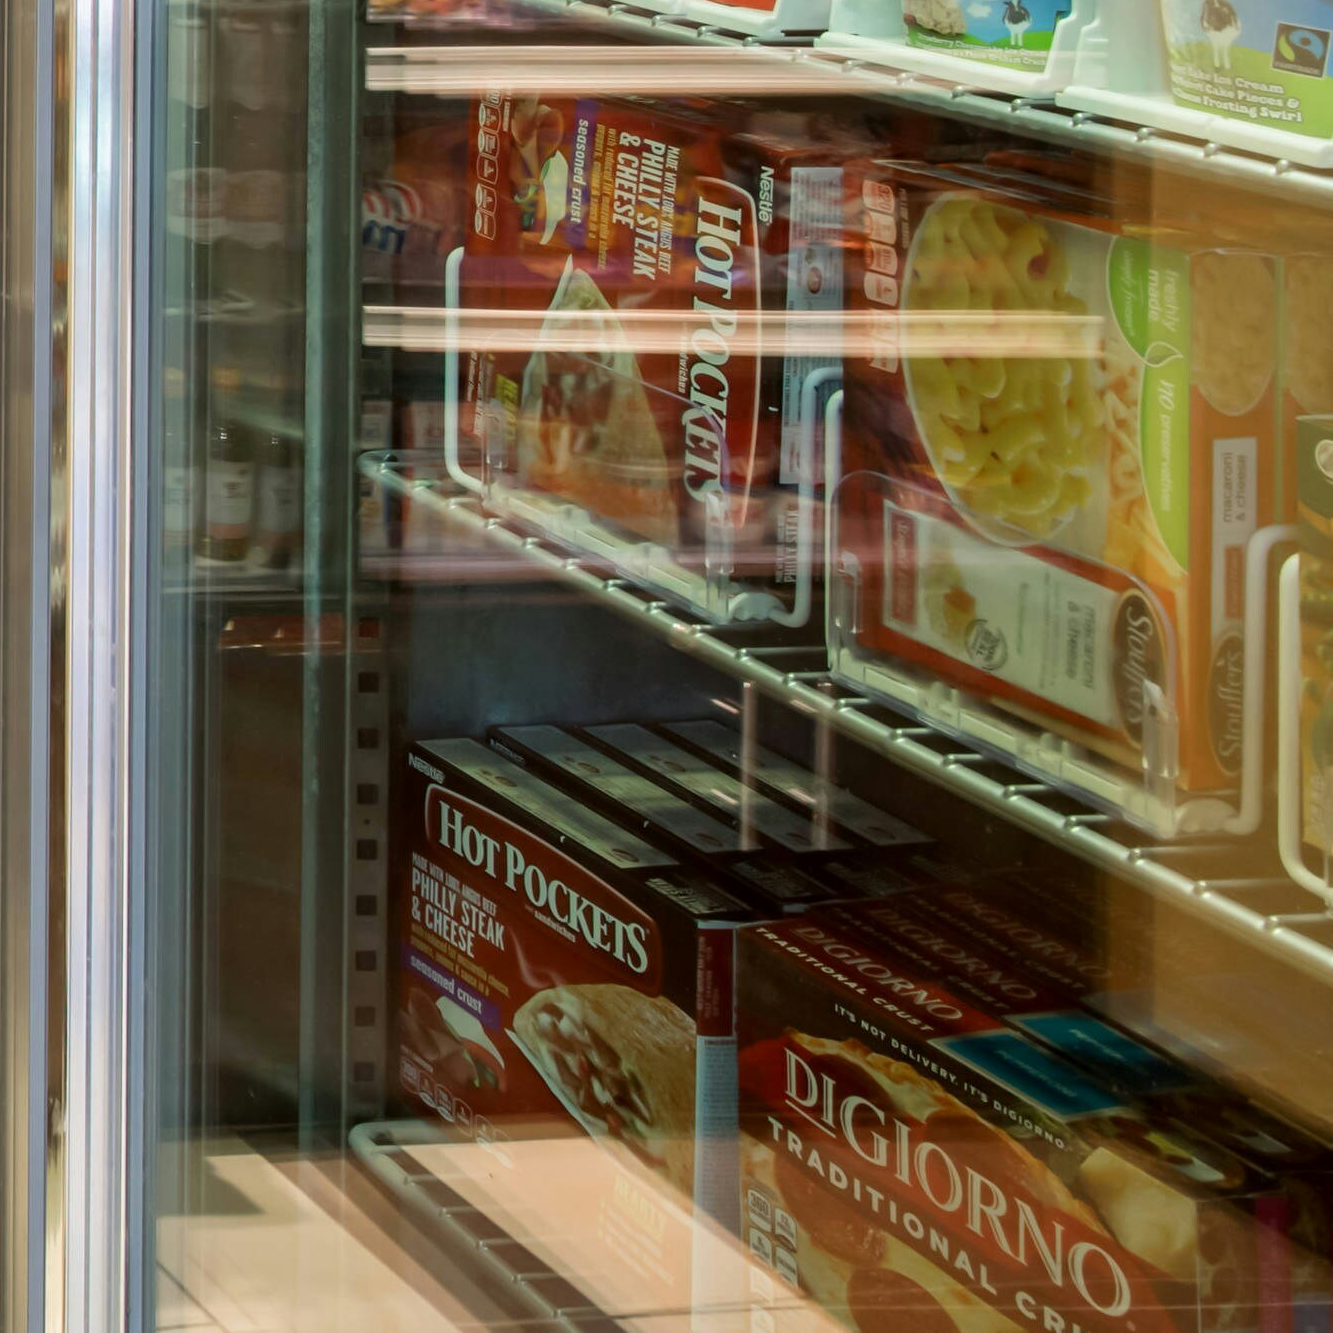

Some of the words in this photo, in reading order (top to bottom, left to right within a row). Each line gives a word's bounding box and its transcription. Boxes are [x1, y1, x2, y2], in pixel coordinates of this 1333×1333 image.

[1203, 95, 1258, 117] Frosting
[1260, 106, 1303, 123] Swirl
[1207, 85, 1234, 100] Cake
[1238, 90, 1283, 108] Pieces
[1286, 98, 1300, 109] &
[573, 118, 589, 185] seasoned
[569, 186, 583, 224] crust
[1149, 268, 1161, 323] made
[1163, 269, 1180, 333] freshly
[1220, 451, 1233, 523] macaroni
[412, 866, 458, 918] PHILLY
[461, 899, 505, 952] STEAK
[438, 799, 500, 878] HOT
[503, 840, 649, 974] POCKETS
[411, 894, 422, 922] &
[424, 904, 475, 960] CHEESE
[755, 926, 867, 996] TRADITIONAL
[871, 994, 935, 1033] CRUST
[793, 927, 964, 1022] DIGIORNO
[767, 1116, 998, 1297] TRADITIONAL
[783, 1047, 1132, 1318] DIGIORNO
